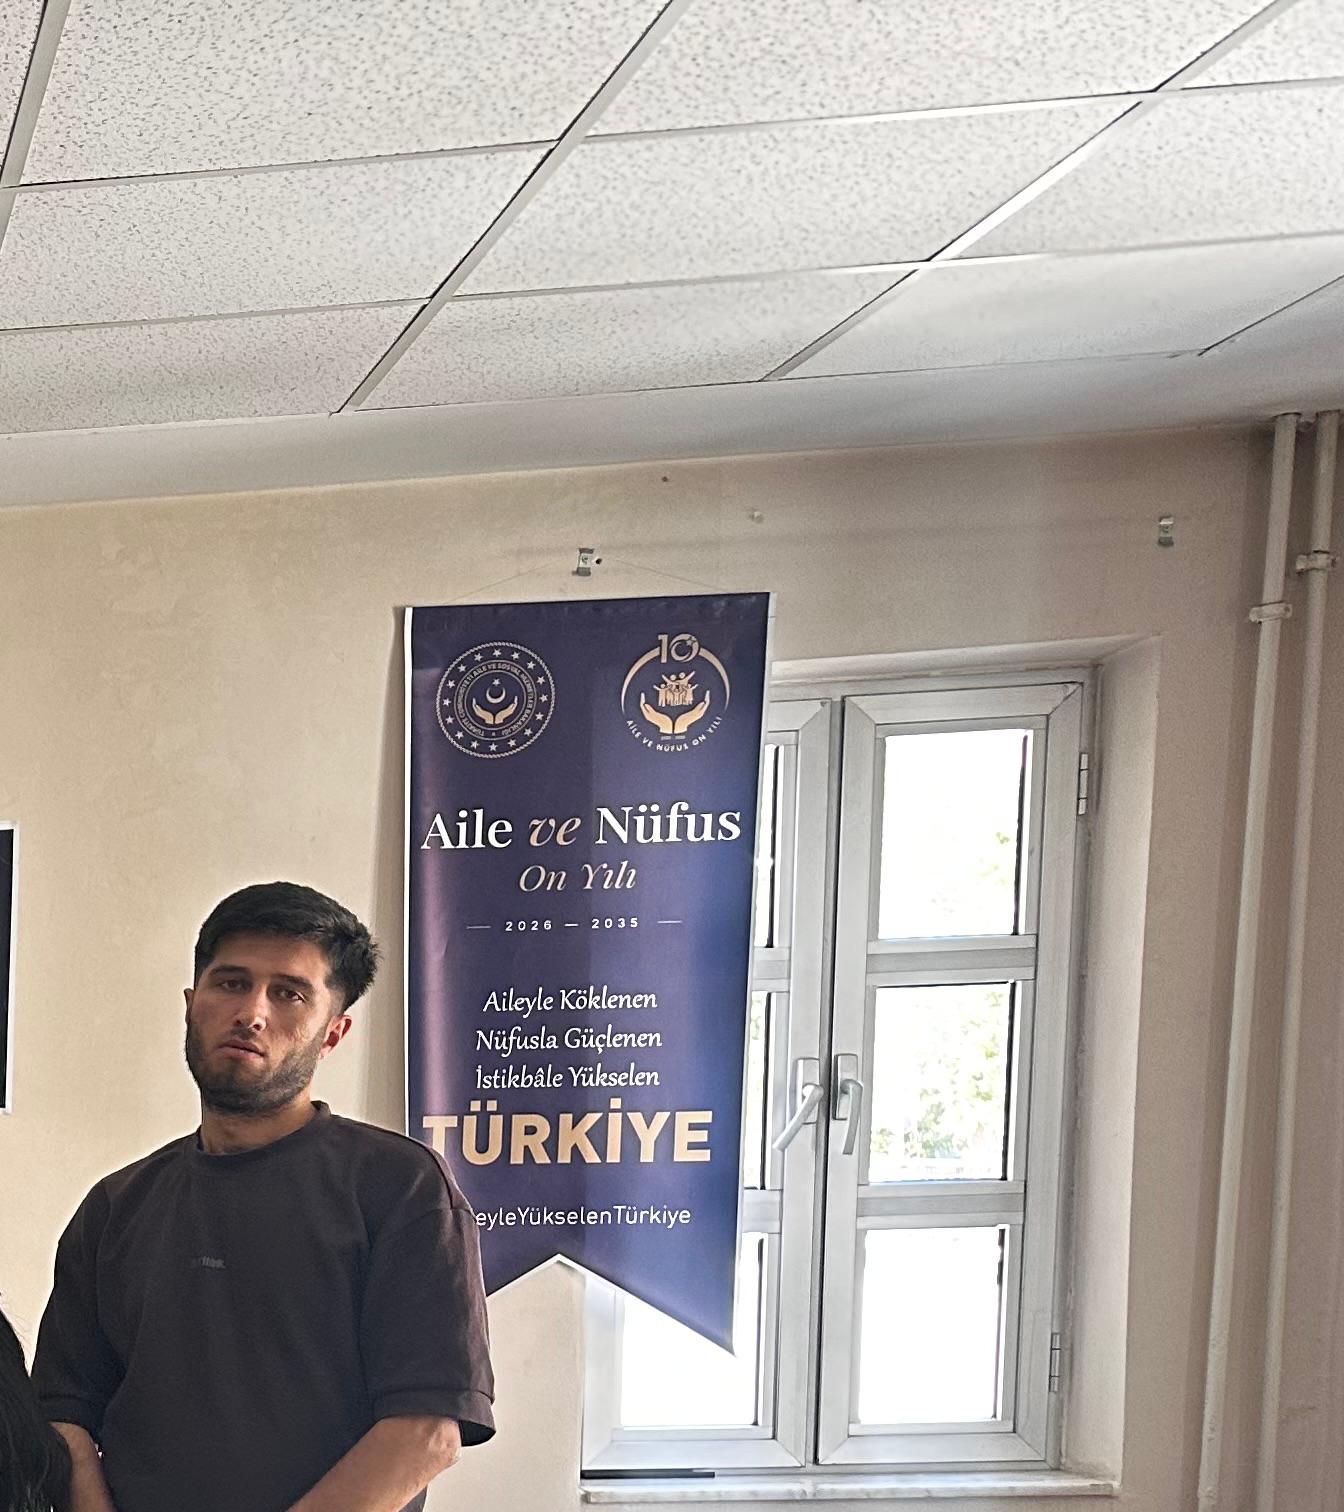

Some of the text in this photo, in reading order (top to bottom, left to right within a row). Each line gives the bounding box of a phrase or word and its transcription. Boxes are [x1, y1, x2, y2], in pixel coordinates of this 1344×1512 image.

[692, 734, 706, 746] ON
[421, 802, 740, 849] Aile ve Nüfus
[520, 861, 636, 891] On Yılı
[506, 918, 638, 931] 2026 2035
[483, 985, 657, 1018] Aileyle Köklenen
[477, 1024, 662, 1057] Nüfusla Güçlenen
[476, 1062, 660, 1088] İstikbâle Yükselen
[422, 1097, 713, 1166] TÜRKİYE
[476, 1205, 691, 1231] eyleYükselenTürkiye
